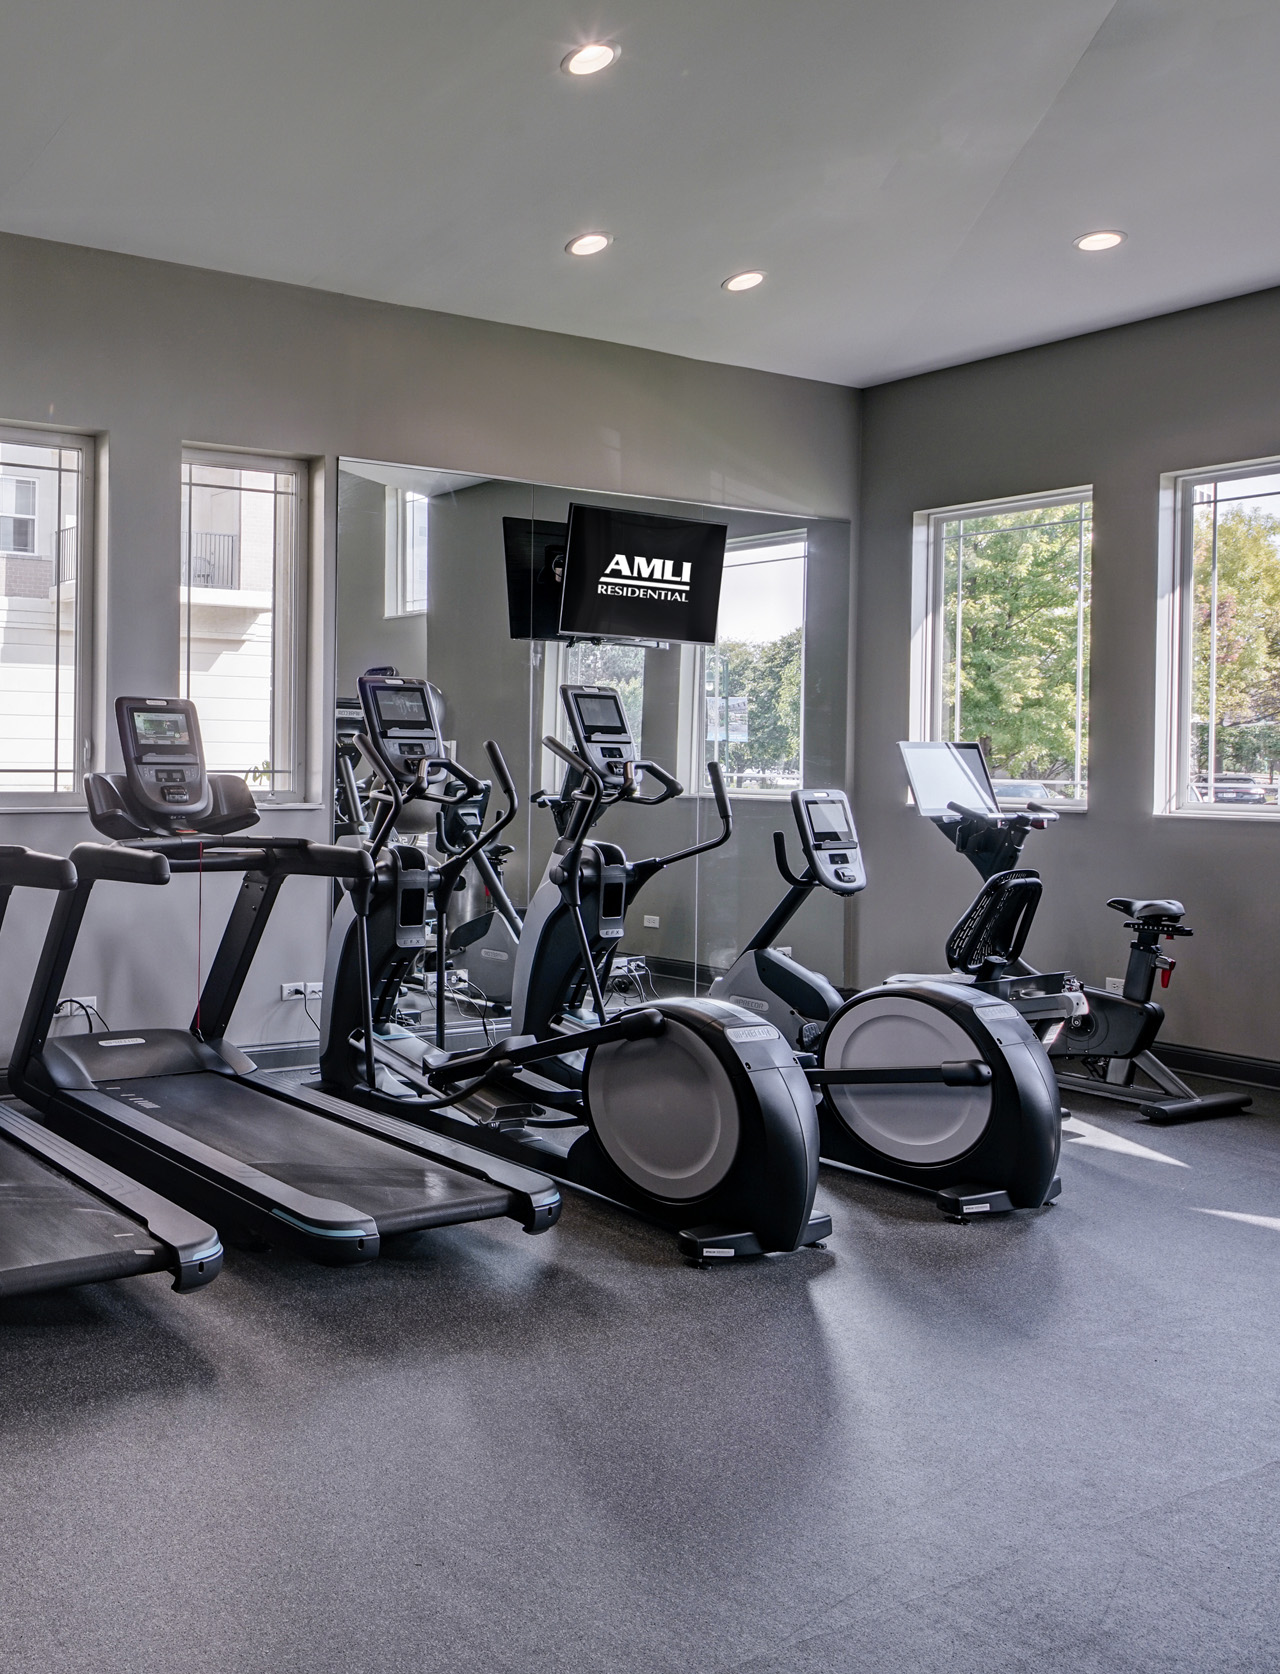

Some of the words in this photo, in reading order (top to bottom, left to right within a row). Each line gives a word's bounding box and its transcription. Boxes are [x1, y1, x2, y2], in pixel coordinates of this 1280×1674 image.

[604, 554, 692, 583] AMLI
[597, 584, 689, 603] RESIDENTIAL
[739, 1000, 764, 1009] PRECOR
